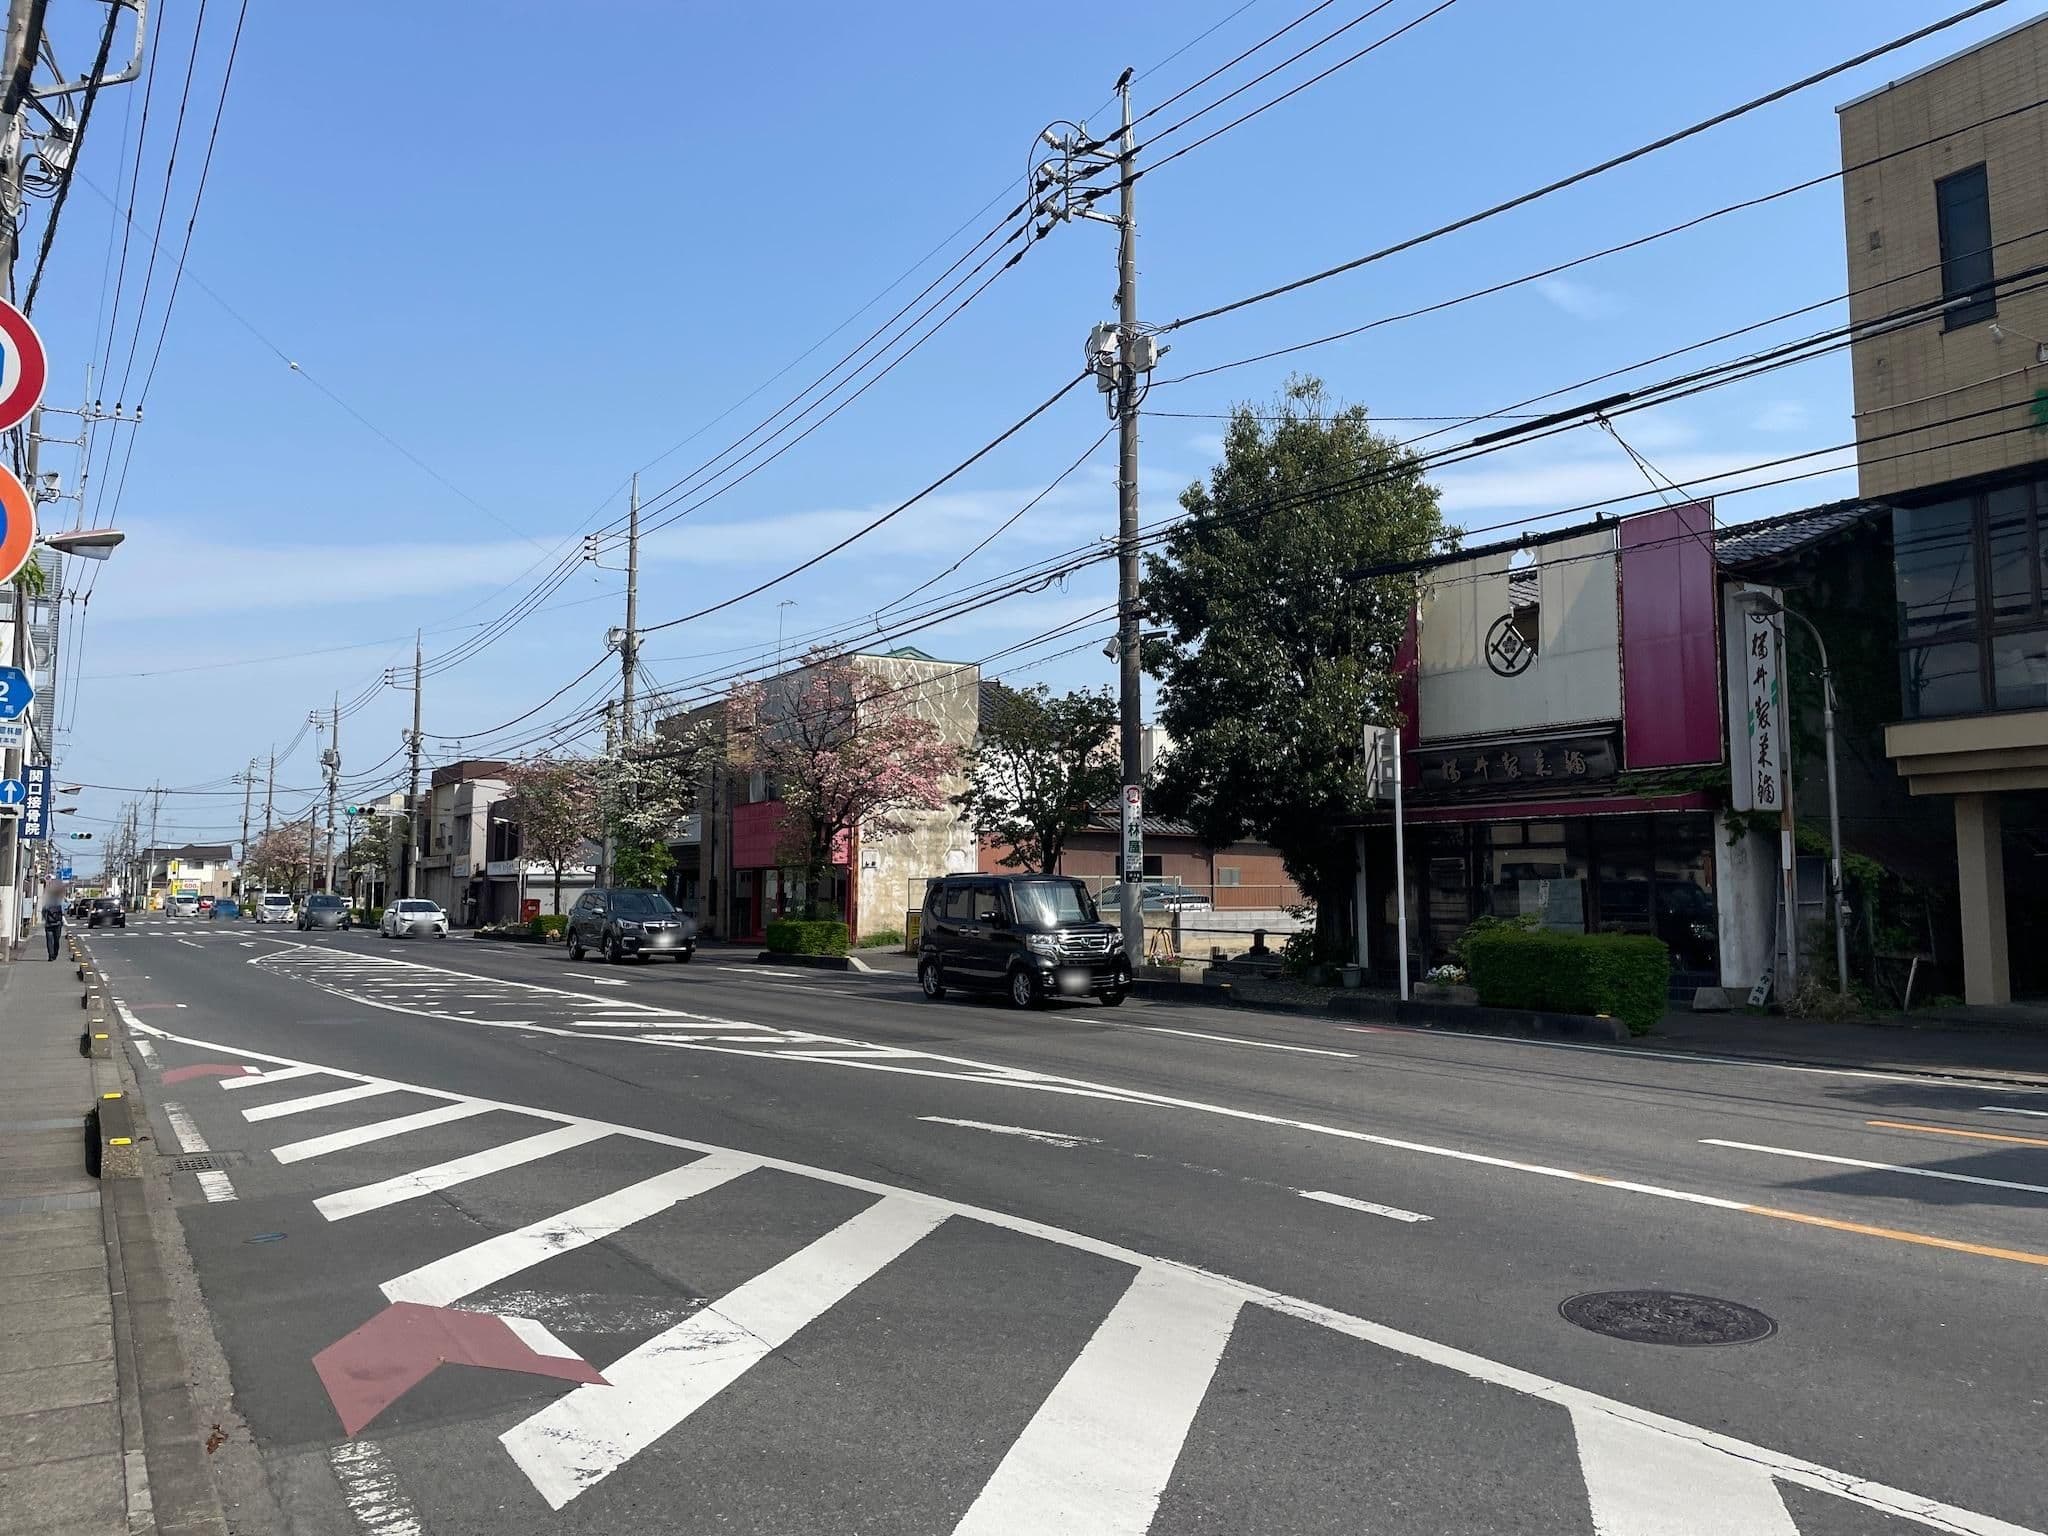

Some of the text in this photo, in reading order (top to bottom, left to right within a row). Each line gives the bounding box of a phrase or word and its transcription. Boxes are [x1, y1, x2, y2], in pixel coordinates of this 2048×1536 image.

[0, 681, 9, 702] 2
[25, 769, 44, 835] 関口接骨院
[1127, 823, 1140, 853] 林屋
